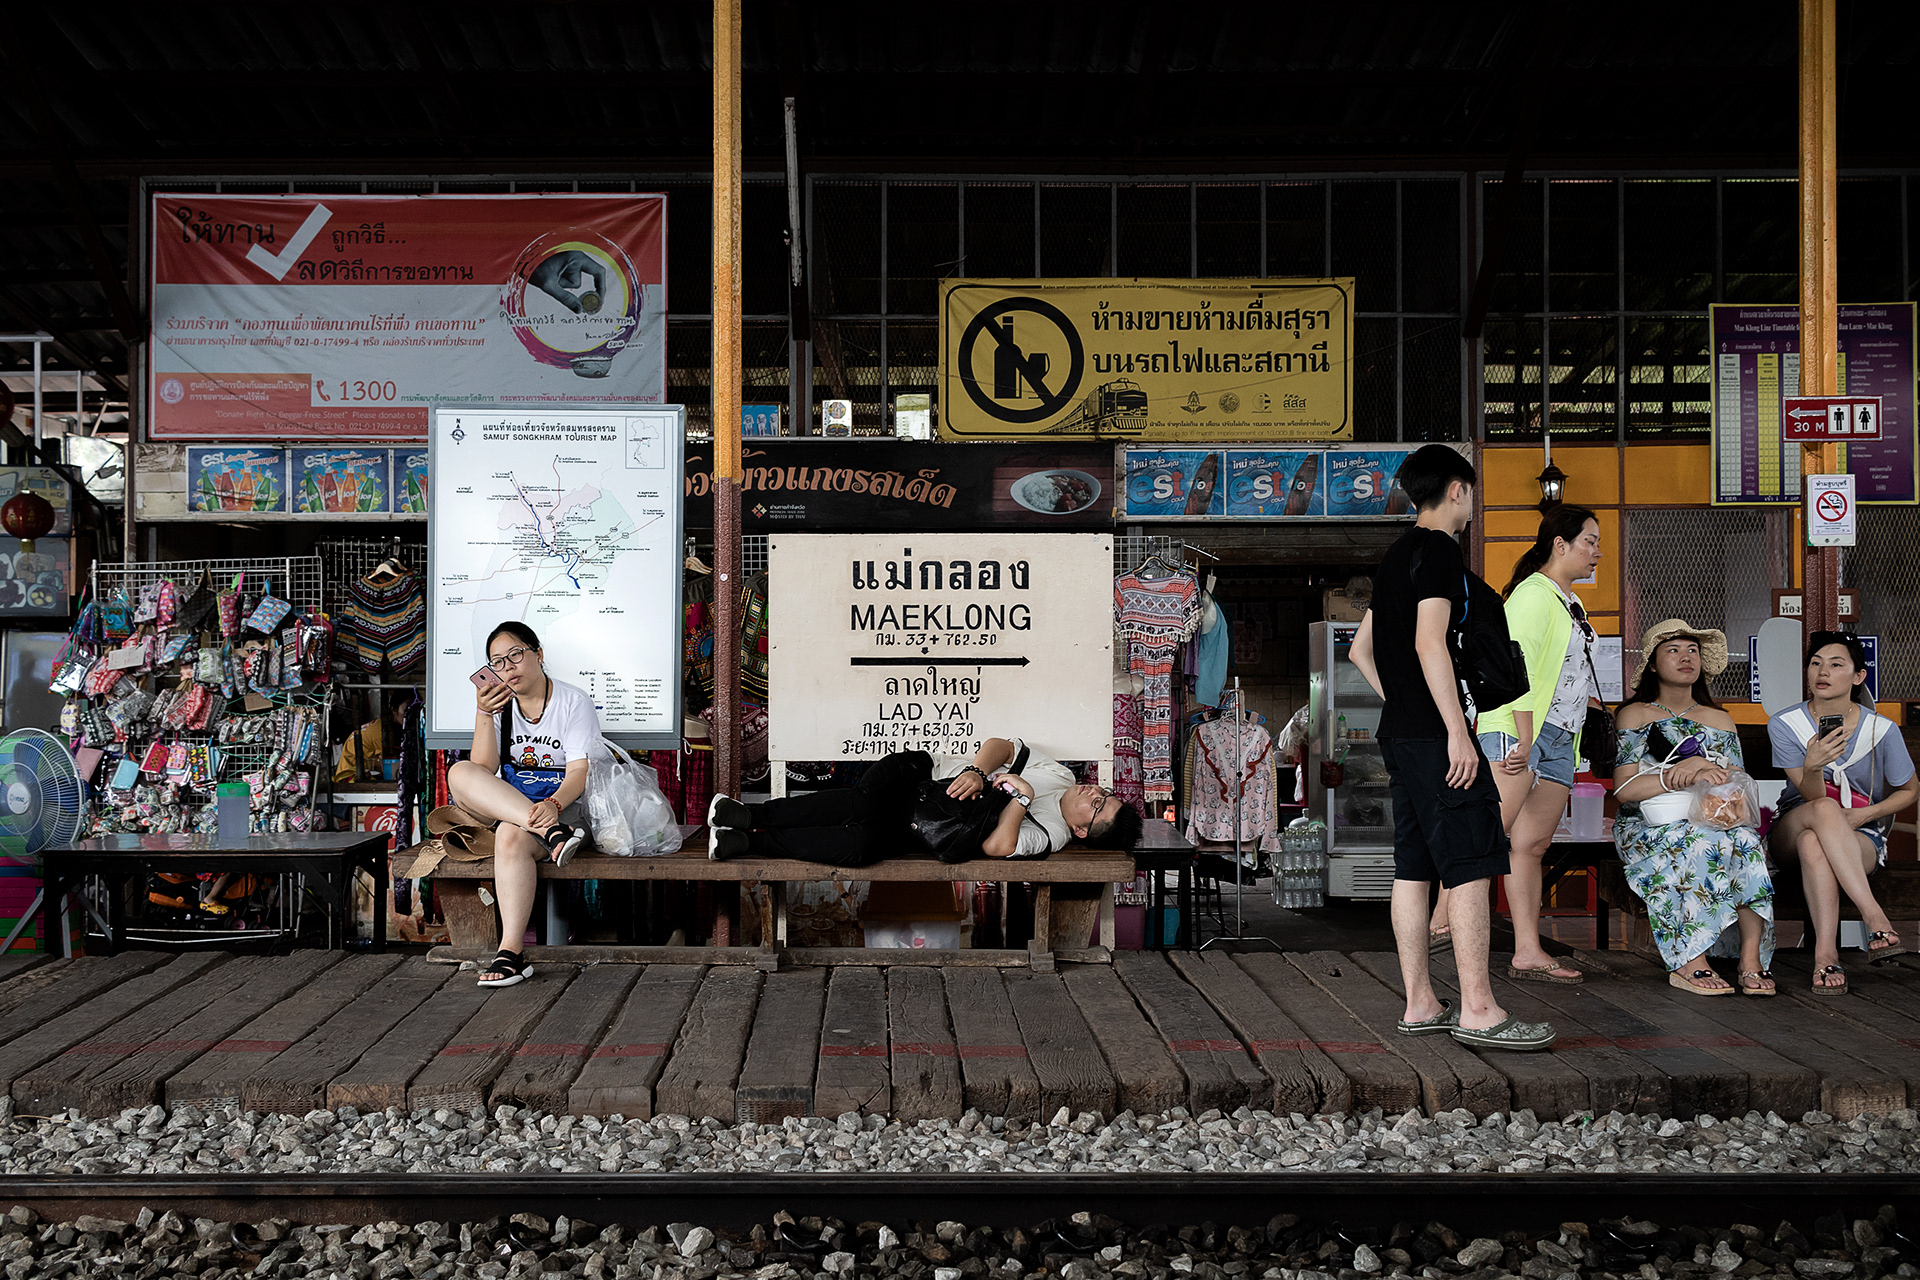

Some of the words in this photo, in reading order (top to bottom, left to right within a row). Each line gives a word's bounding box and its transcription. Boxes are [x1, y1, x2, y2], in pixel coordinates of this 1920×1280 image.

[175, 206, 275, 244] ให้ทาน
[297, 258, 473, 281] ลดวิถีการขอทาน
[166, 316, 229, 330] ร่วมบริจาค
[1092, 293, 1330, 339] ห้ามขายห้ามดื่มสุรา
[294, 338, 359, 347] 021-0-17499-4
[1092, 340, 1330, 373] บนรถไฟและสถานี
[340, 381, 396, 401] 1300
[352, 411, 376, 419] Please
[378, 411, 405, 419] donate
[483, 434, 510, 442] SAMUT
[513, 434, 561, 442] SONGKHRAM
[565, 434, 598, 442] TOURIST
[600, 434, 617, 442] MAP
[1793, 422, 1810, 432] 30
[1815, 422, 1825, 432] M
[201, 452, 225, 467] est
[304, 452, 327, 468] est
[1130, 471, 1184, 504] est
[1230, 471, 1284, 504] est
[1330, 471, 1384, 504] est
[852, 547, 1030, 590] แม่กลอง
[850, 604, 1031, 631] MAEKLONG
[884, 666, 982, 704] ลาดใหญ่
[879, 703, 923, 721] LAD
[933, 703, 970, 721] YAI
